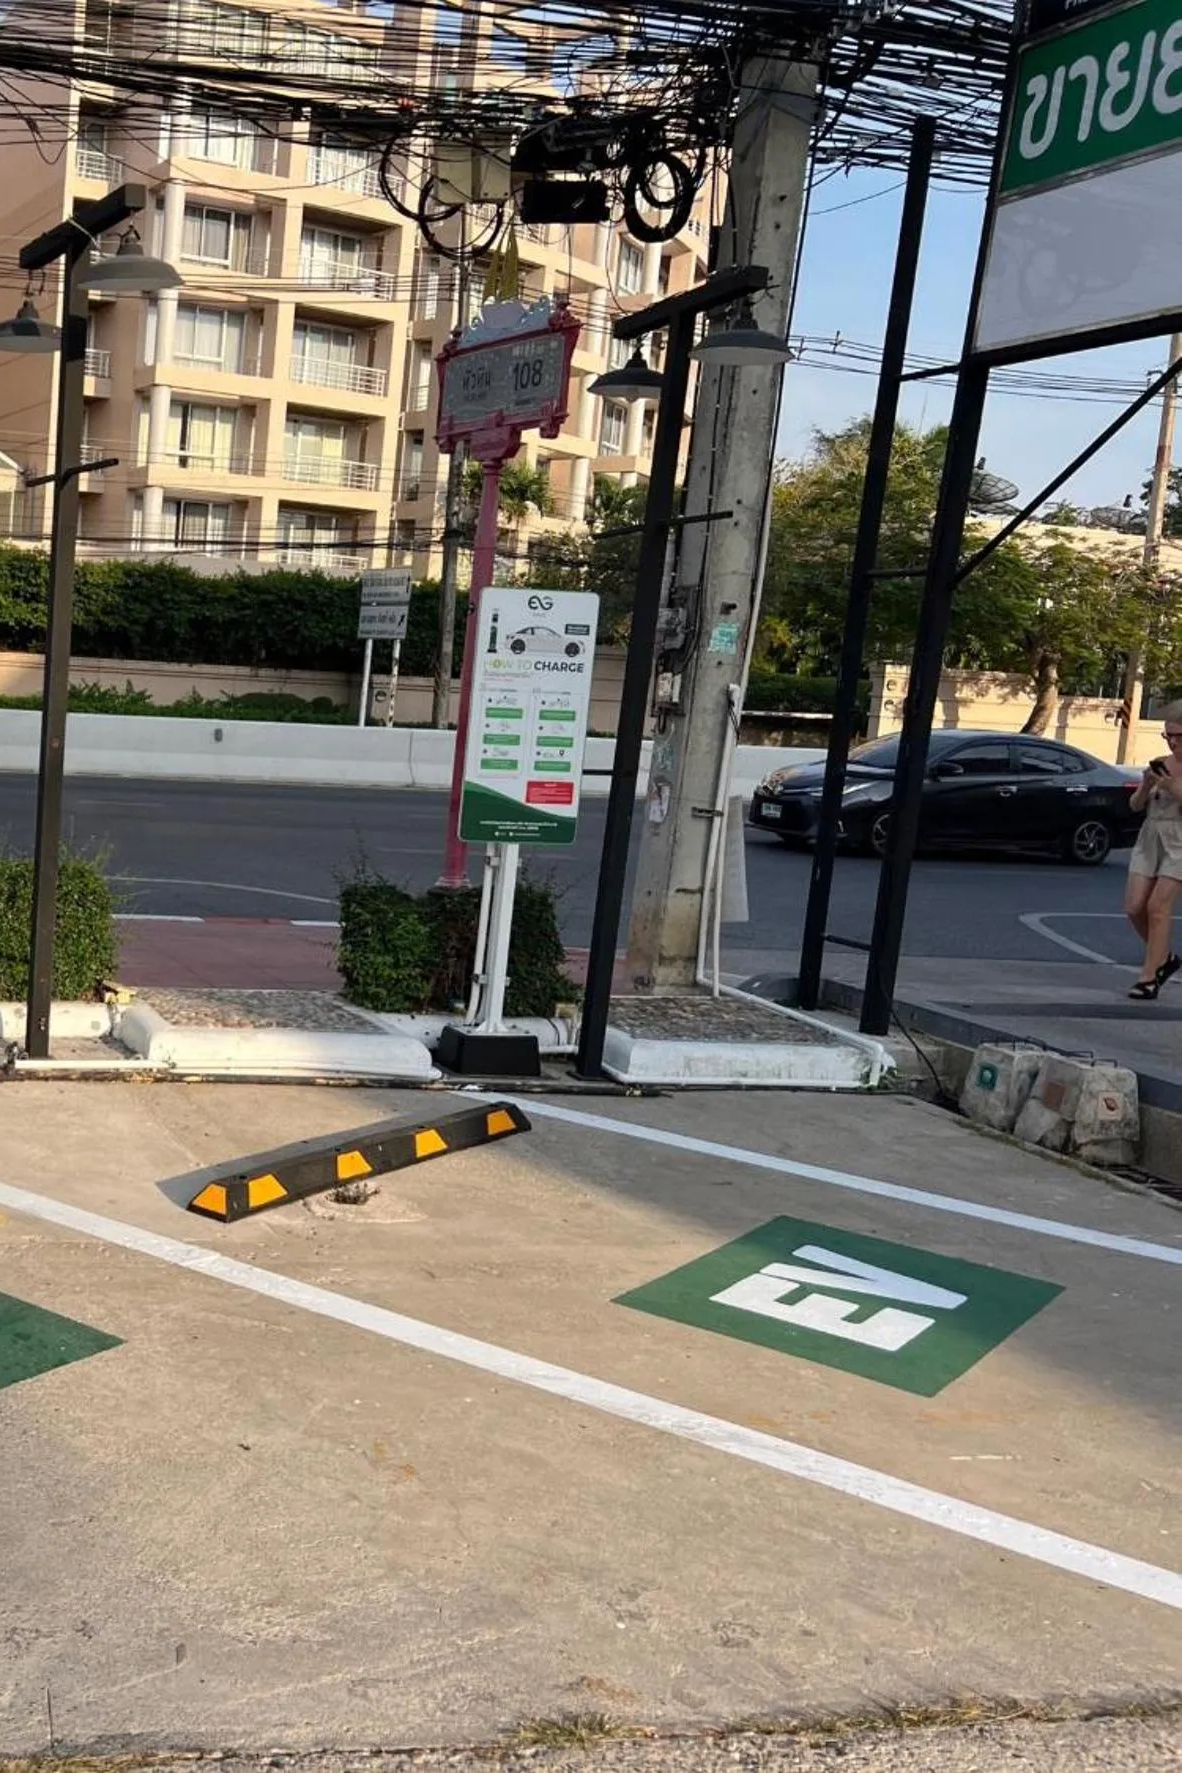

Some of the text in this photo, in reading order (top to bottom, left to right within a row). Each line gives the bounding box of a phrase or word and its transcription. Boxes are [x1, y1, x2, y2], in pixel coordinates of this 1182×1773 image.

[513, 359, 543, 391] 108
[483, 659, 584, 673] HOW TO CHARGE
[709, 1244, 968, 1352] EV
